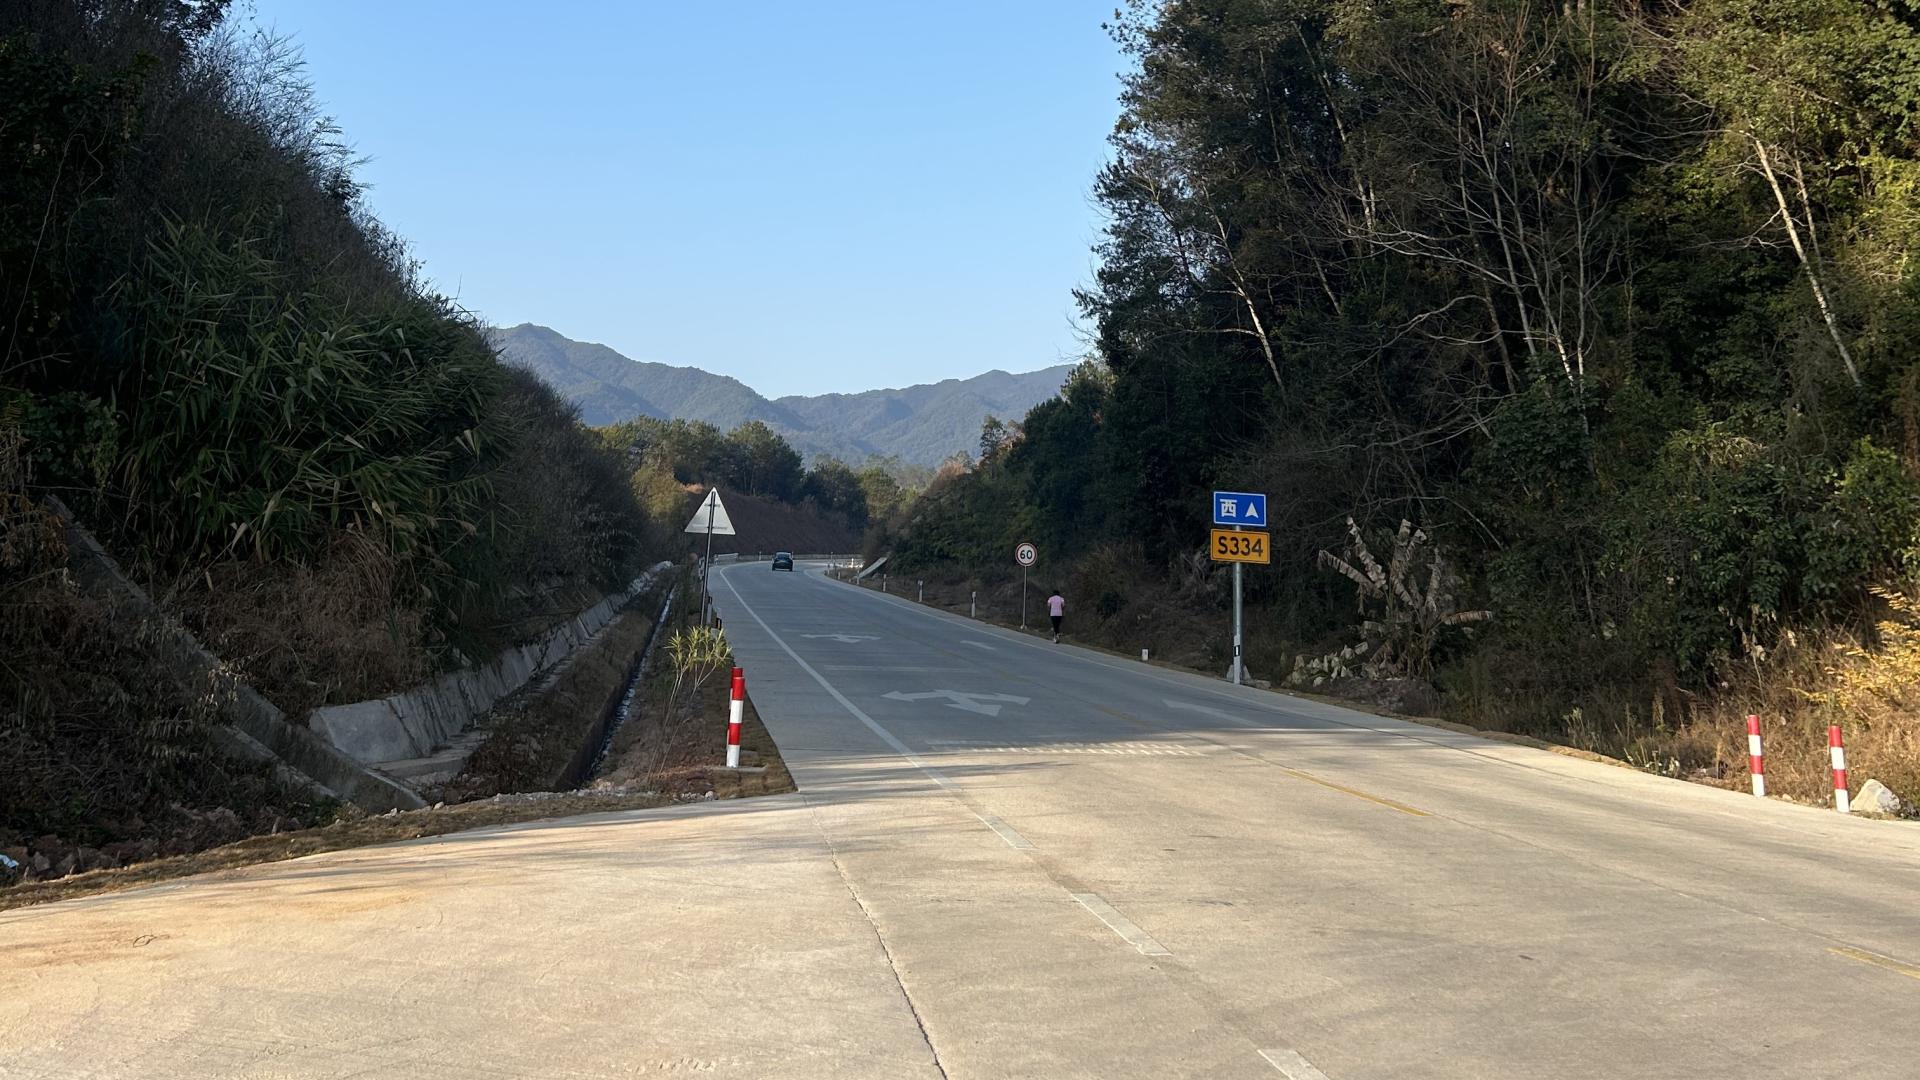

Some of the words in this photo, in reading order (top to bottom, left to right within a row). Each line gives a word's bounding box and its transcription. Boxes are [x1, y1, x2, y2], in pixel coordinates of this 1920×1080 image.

[1220, 499, 1237, 517] 西
[1020, 550, 1033, 560] 60
[1218, 536, 1263, 557] S334
